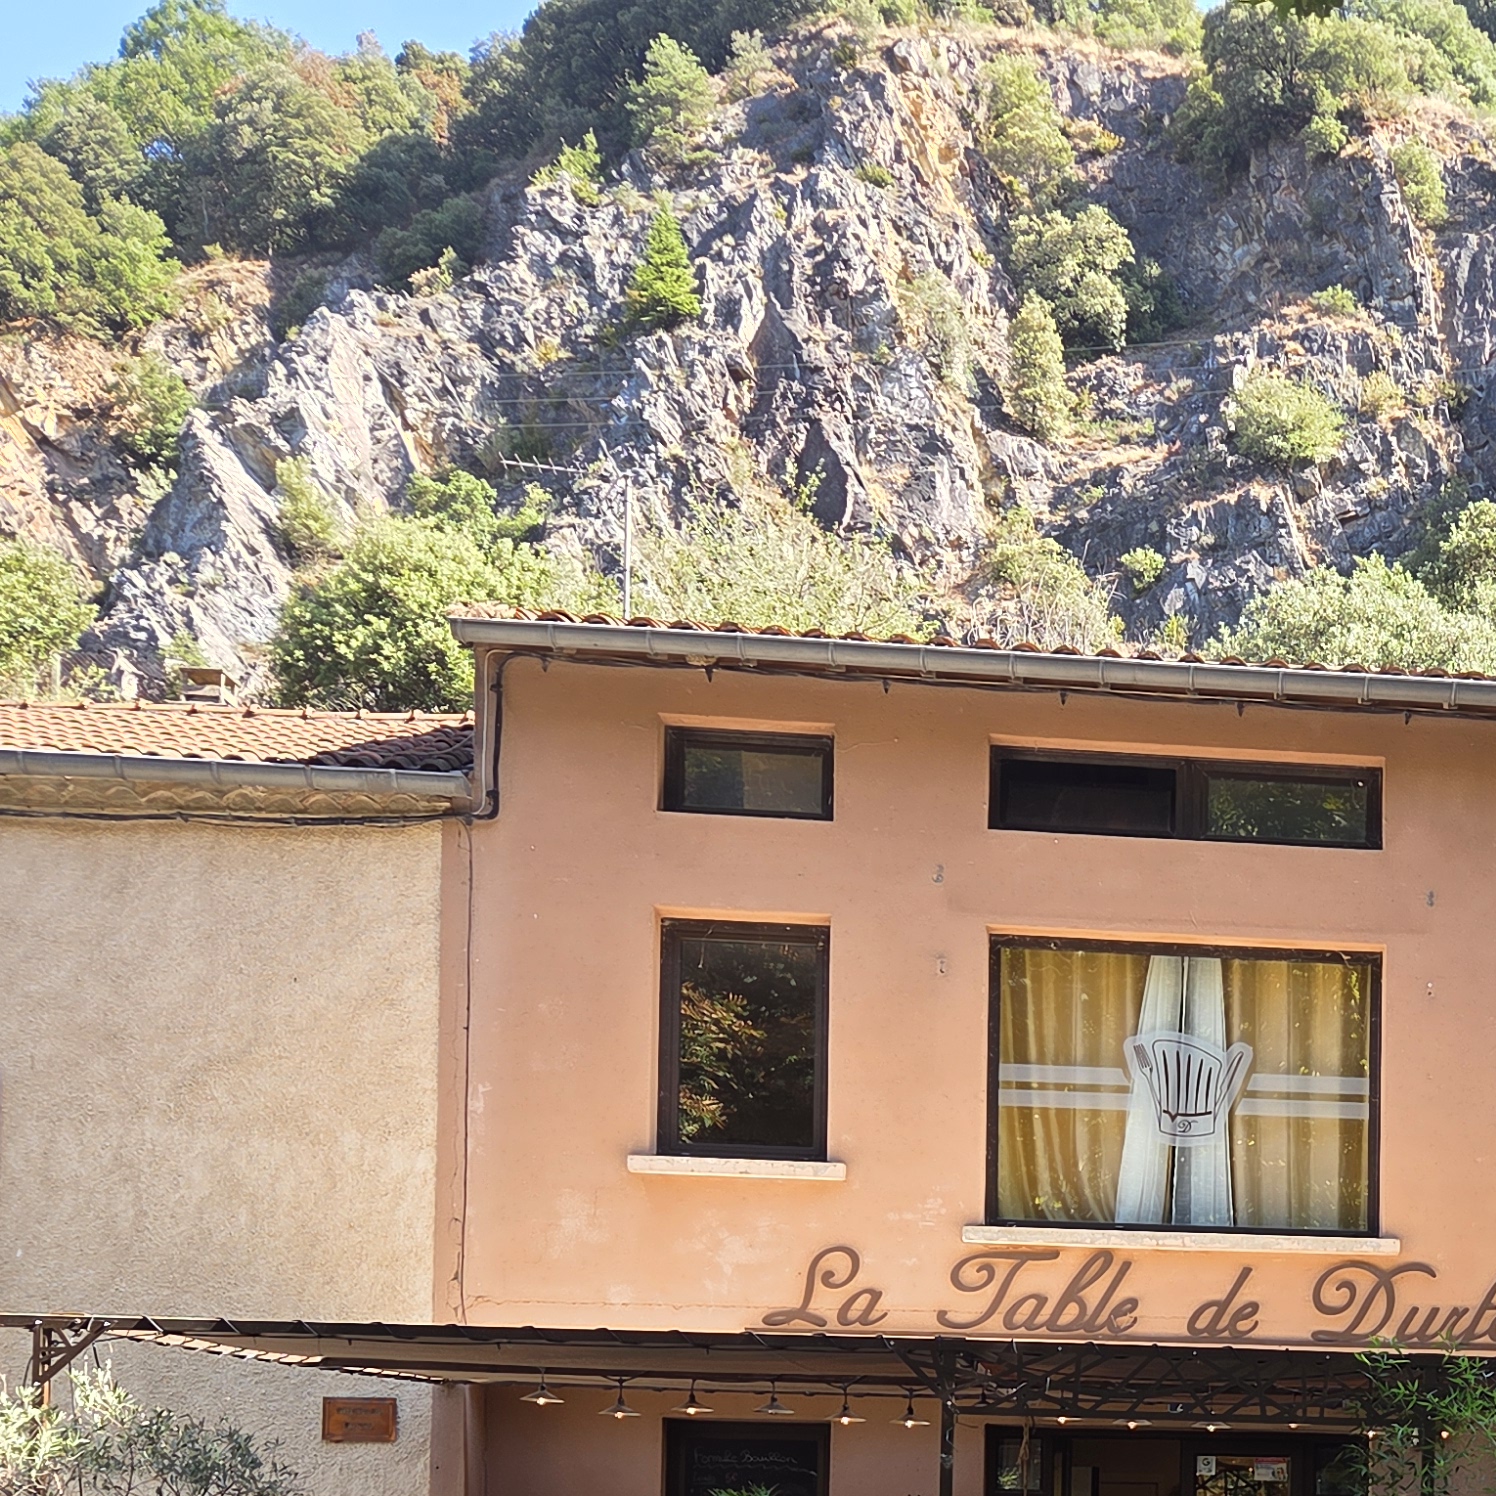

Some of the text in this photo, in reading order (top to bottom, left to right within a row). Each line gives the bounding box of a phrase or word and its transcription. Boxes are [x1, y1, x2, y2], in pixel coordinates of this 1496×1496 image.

[762, 1246, 888, 1327] La
[937, 1251, 1140, 1334] Table
[1186, 1266, 1261, 1338] de
